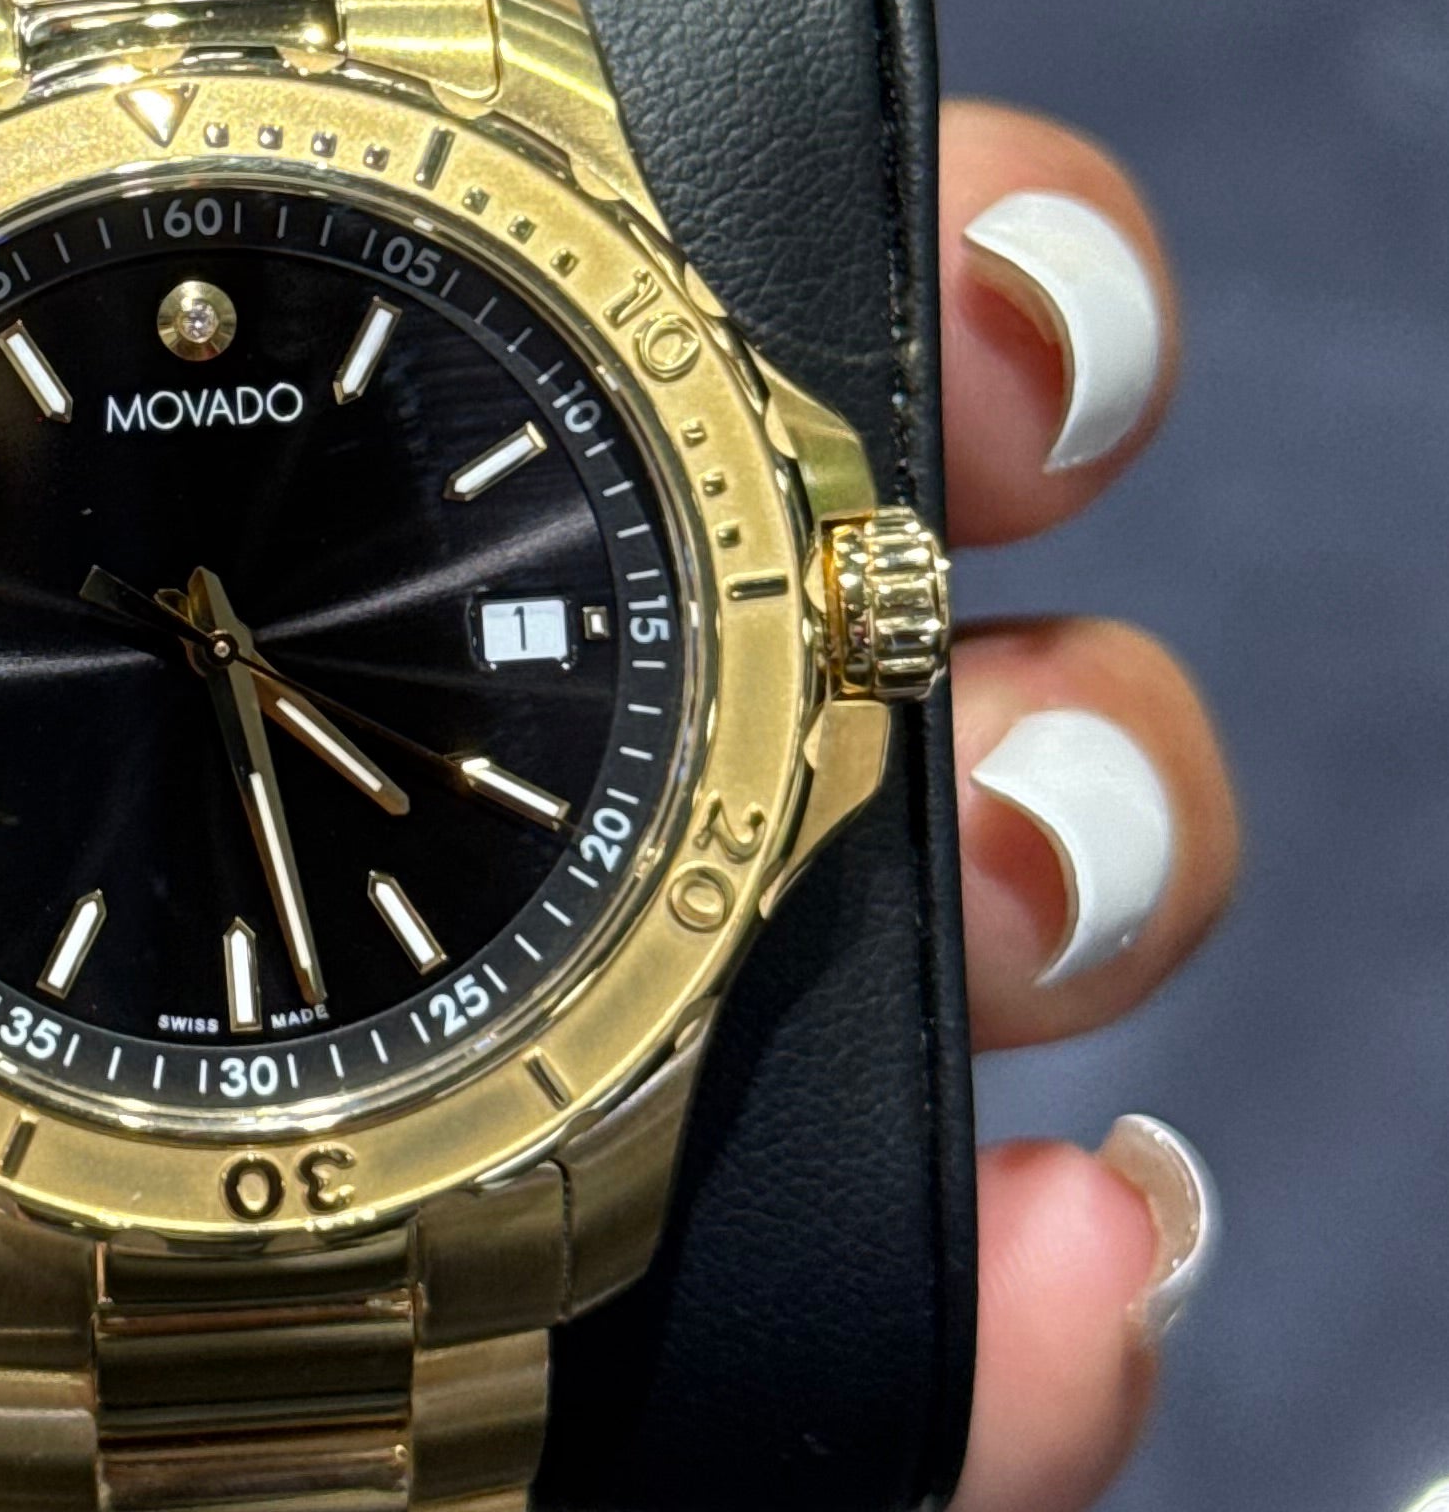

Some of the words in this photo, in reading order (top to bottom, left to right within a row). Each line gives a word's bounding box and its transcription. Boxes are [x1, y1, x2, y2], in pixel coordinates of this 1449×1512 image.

[162, 199, 224, 238] 60
[380, 236, 442, 286] 05
[603, 268, 701, 383] 10
[105, 382, 304, 433] MOVADO
[551, 382, 603, 434] 10
[511, 605, 528, 652] 1
[625, 594, 671, 644] 15
[579, 806, 632, 871] 20
[665, 788, 768, 932] 20
[0, 1006, 63, 1060] 35
[157, 1014, 220, 1034] SWISS
[270, 1004, 330, 1030] MADE
[429, 980, 491, 1037] 25
[218, 1055, 279, 1097] 30
[222, 1144, 356, 1223] 30
